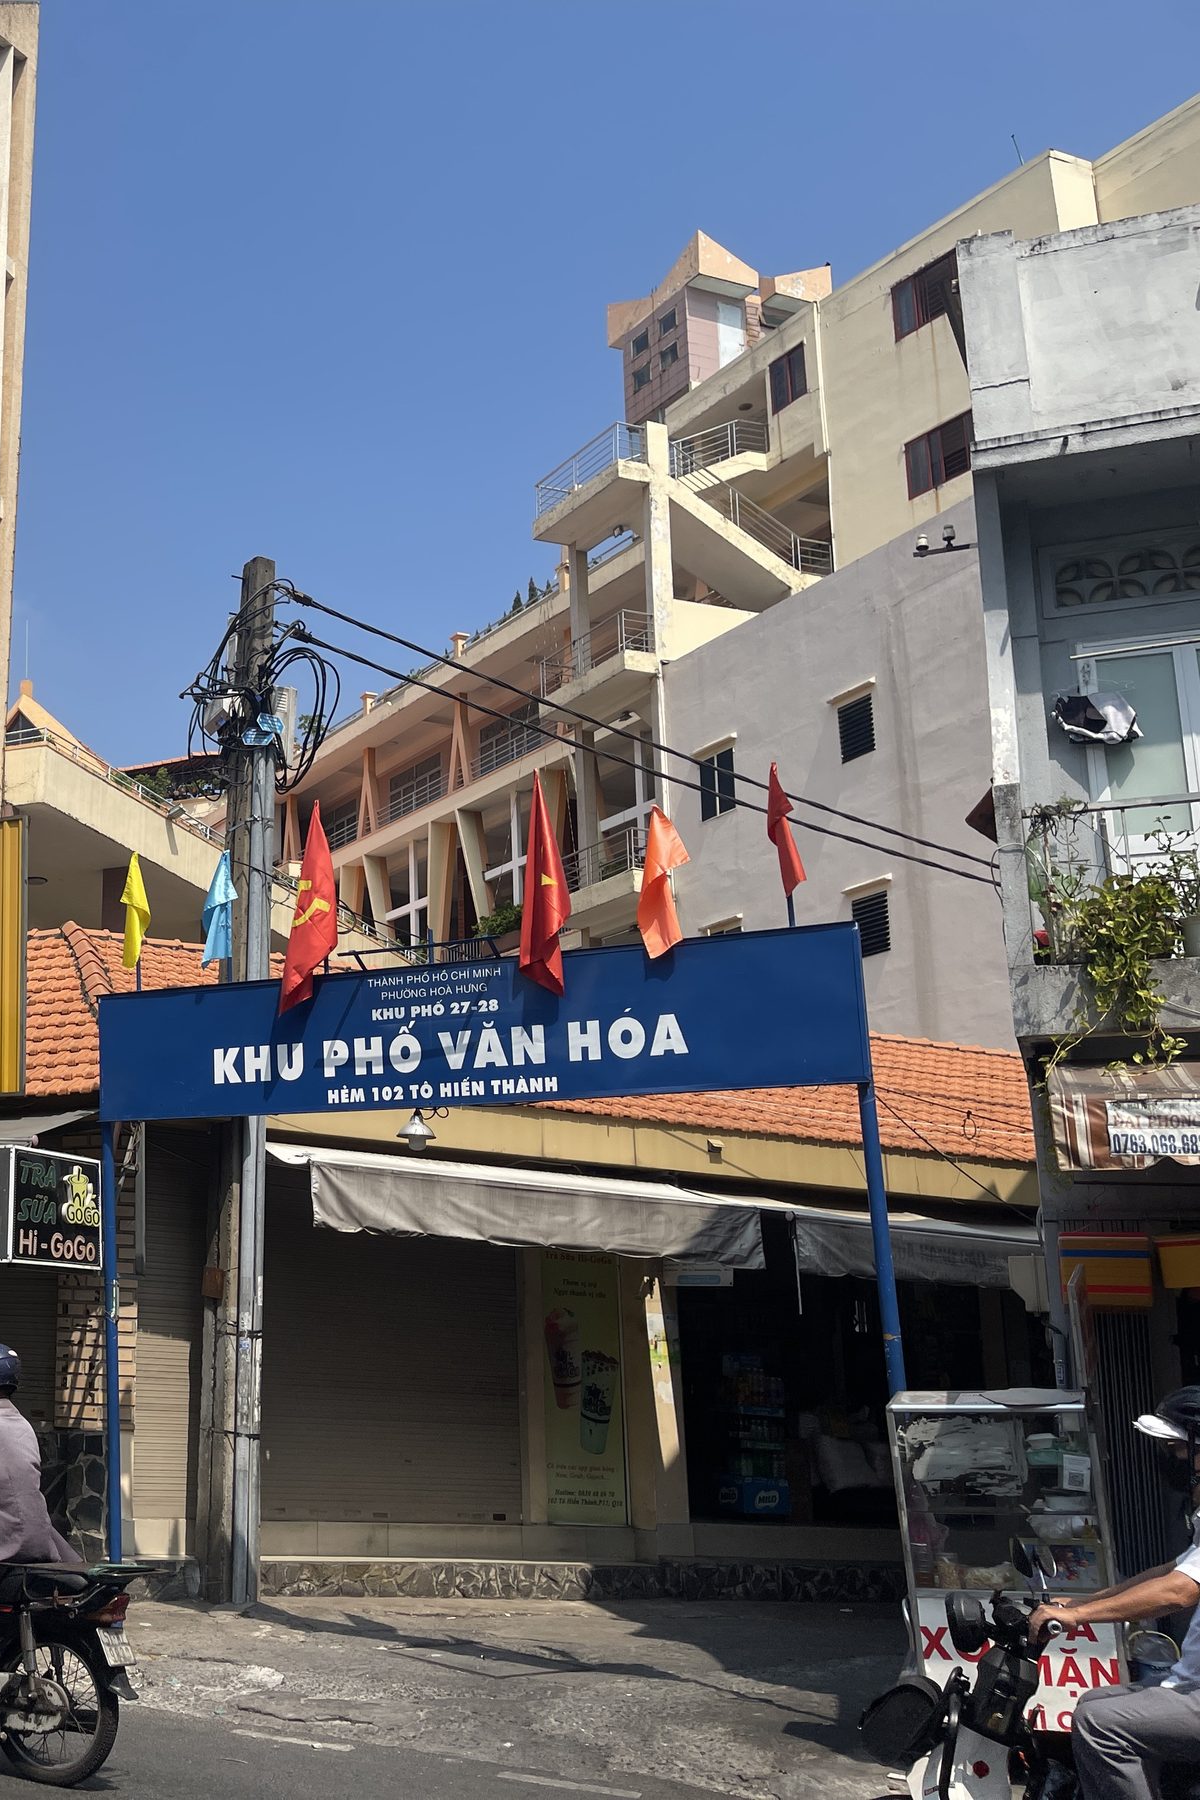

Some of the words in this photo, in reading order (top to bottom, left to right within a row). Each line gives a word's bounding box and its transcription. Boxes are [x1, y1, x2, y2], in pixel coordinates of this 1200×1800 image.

[367, 975, 404, 988] THÀNH
[406, 970, 430, 984] PHỐ
[432, 969, 449, 982] HỒ
[450, 969, 470, 981] CHÍ
[472, 967, 502, 979] MINH
[381, 988, 427, 1001] PHƯỜNG
[429, 984, 453, 997] HOÀ
[455, 982, 488, 994] HƯNG
[371, 1005, 406, 1021] KHU
[410, 1000, 446, 1018] PHỐ
[449, 998, 499, 1015] 27-28
[213, 1042, 304, 1085] KHU
[322, 1019, 423, 1079] PHỐ
[436, 1022, 546, 1071] VĂN
[567, 1006, 690, 1063] HÓA
[327, 1085, 366, 1104] HẺM
[371, 1086, 404, 1102] 102
[409, 1081, 434, 1099] TÔ
[439, 1077, 486, 1097] HIẾN
[490, 1075, 559, 1095] THÀNH
[1112, 1133, 1200, 1155] 0763.068.68
[19, 1160, 57, 1188] TRÀ
[17, 1194, 57, 1225] SỮA
[758, 1495, 777, 1504] MILO
